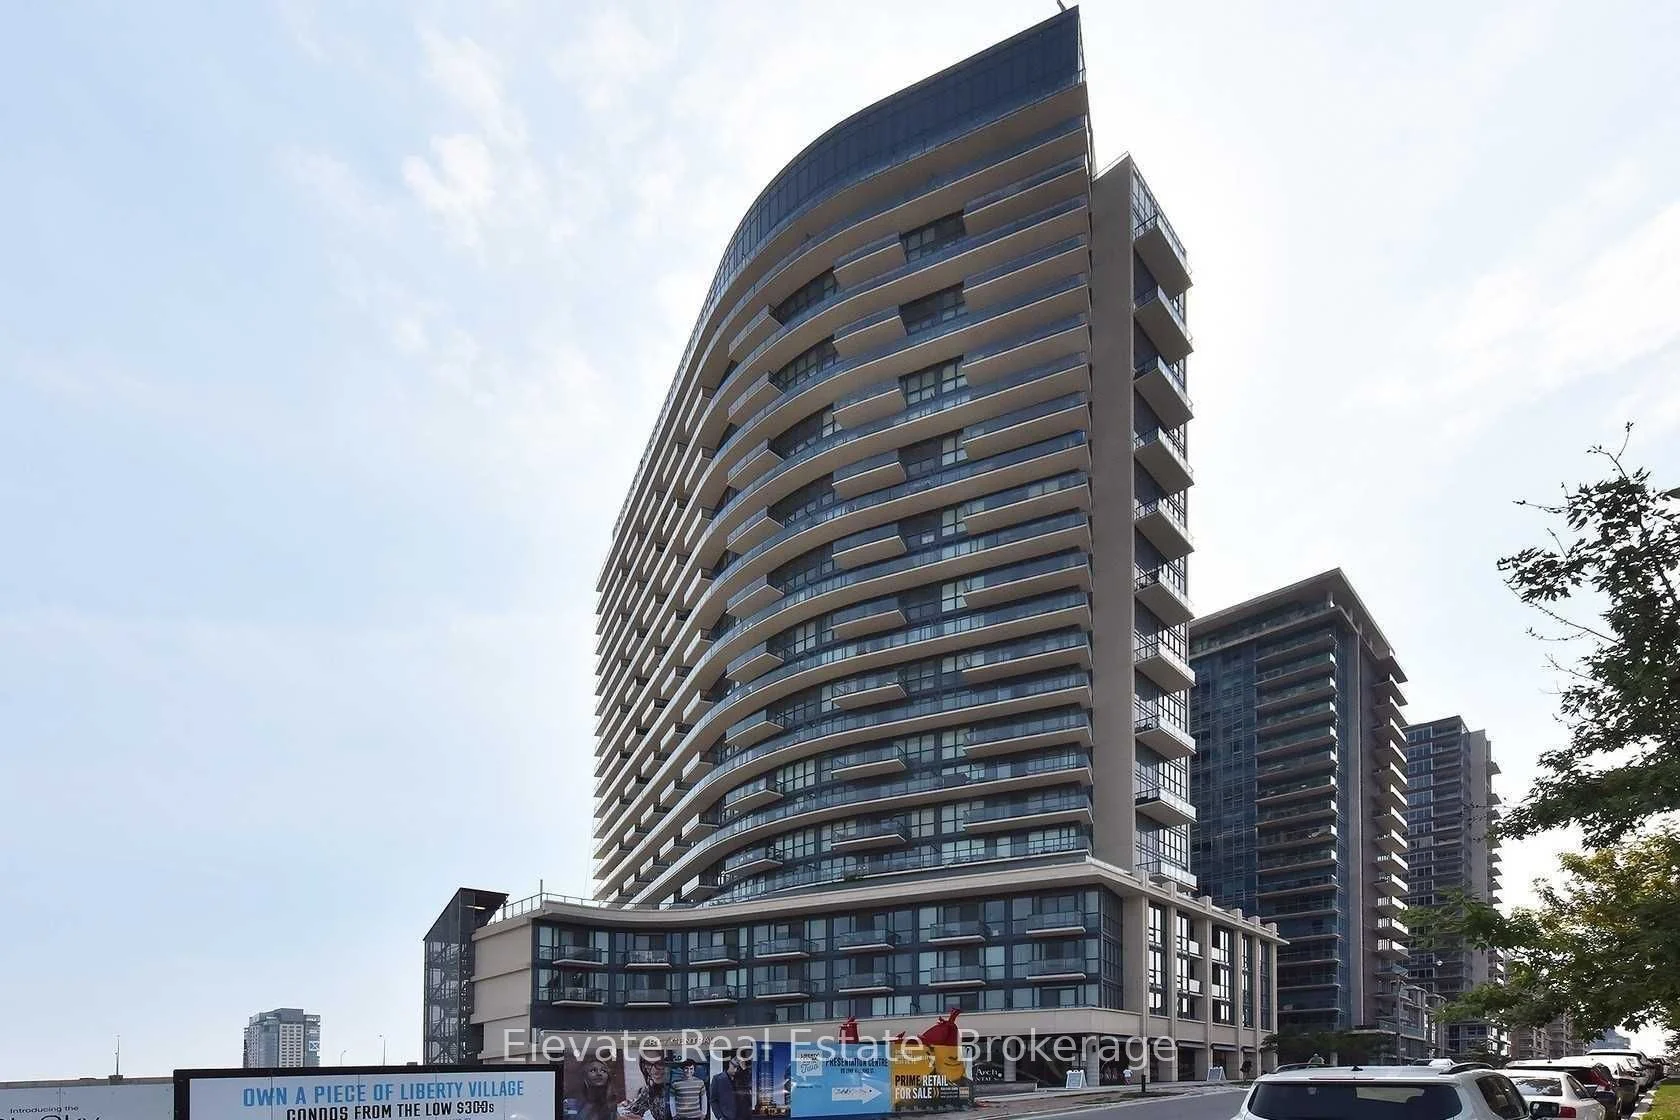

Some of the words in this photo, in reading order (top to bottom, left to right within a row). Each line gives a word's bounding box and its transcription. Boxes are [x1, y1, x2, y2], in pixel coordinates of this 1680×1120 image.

[895, 1075, 920, 1086] PRIME
[922, 1075, 948, 1086] RETAIL
[243, 1087, 287, 1107] OWN
[295, 1086, 307, 1105] A
[314, 1084, 367, 1104] PIECE
[373, 1083, 394, 1101] OF
[400, 1082, 463, 1101] LIBERTY
[468, 1080, 524, 1098] VILLAGE
[895, 1087, 911, 1099] FOR
[912, 1087, 932, 1099] SALE
[286, 1106, 349, 1120] CONDOS
[354, 1104, 392, 1119] FROM
[398, 1103, 421, 1118] THE
[425, 1101, 452, 1116] LOW
